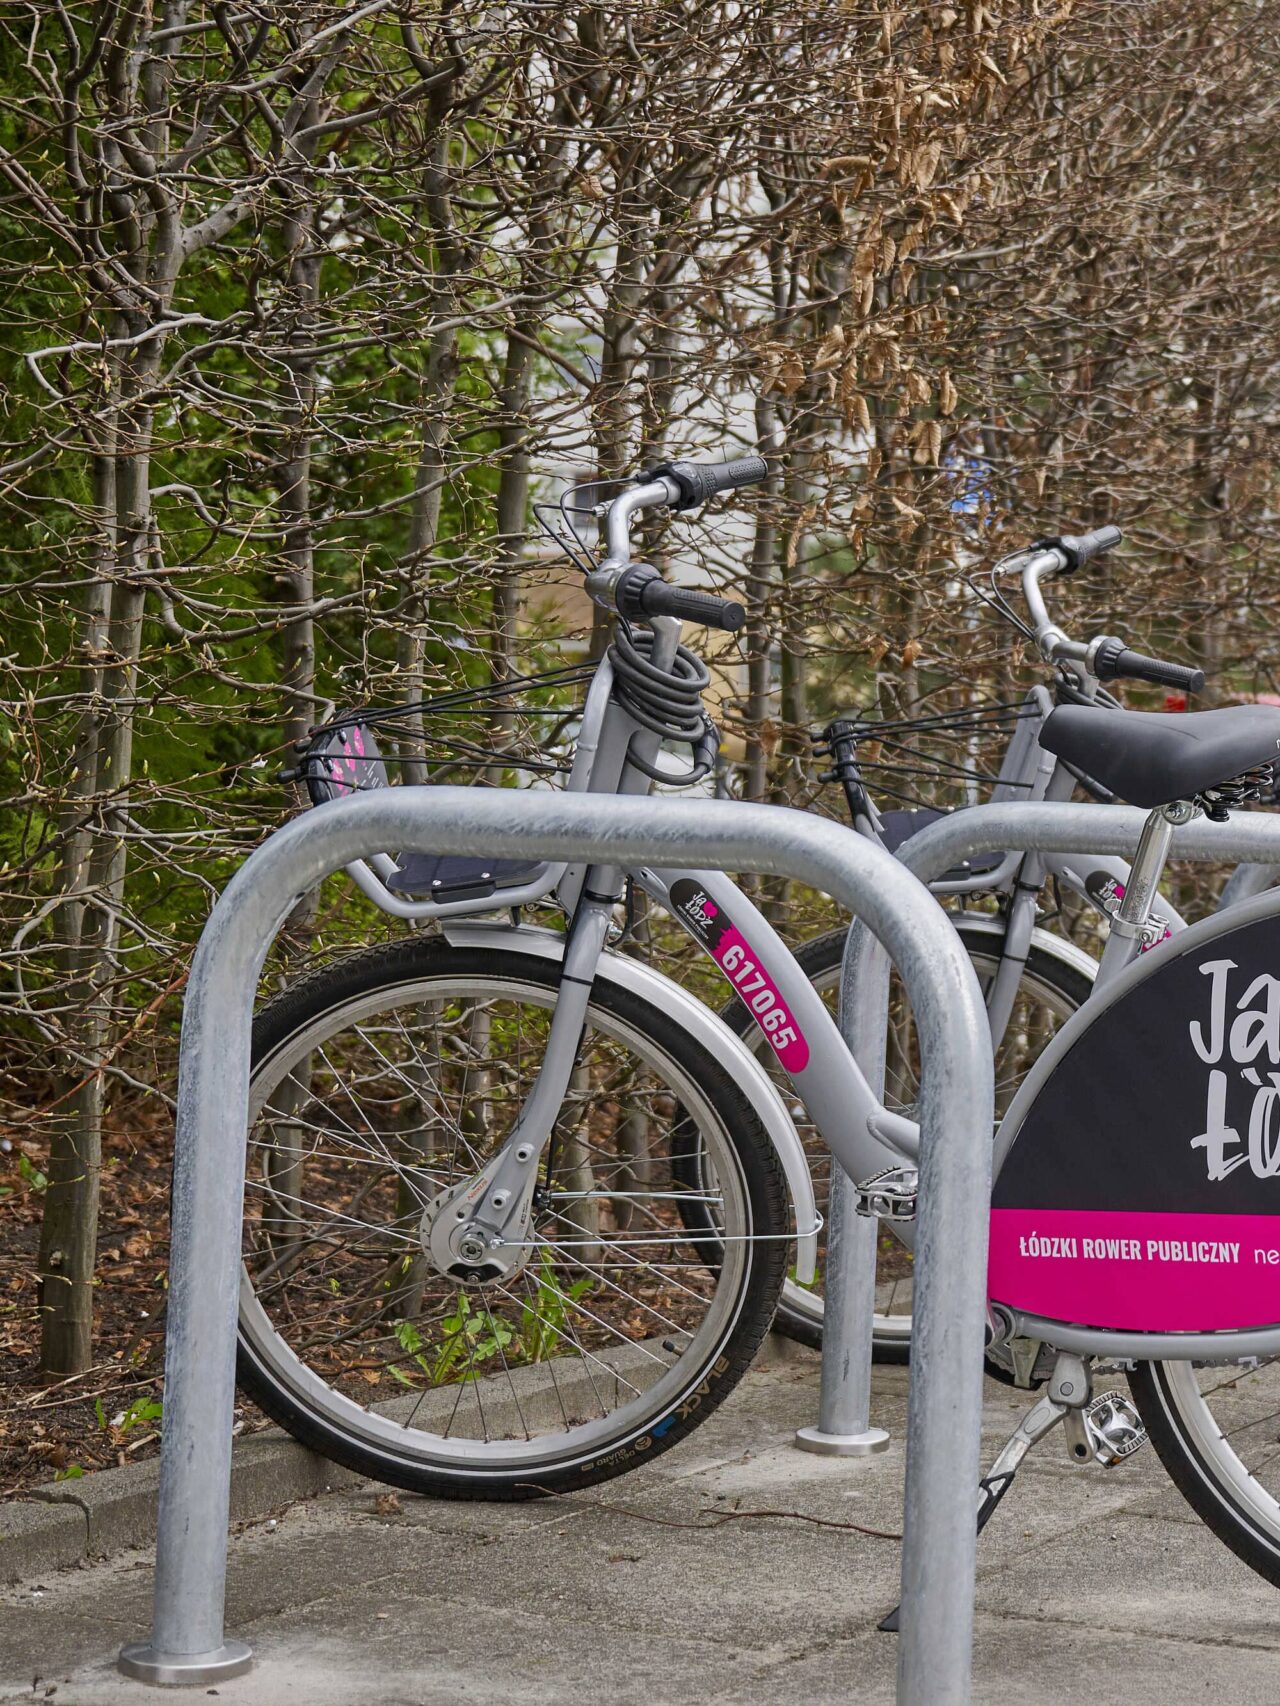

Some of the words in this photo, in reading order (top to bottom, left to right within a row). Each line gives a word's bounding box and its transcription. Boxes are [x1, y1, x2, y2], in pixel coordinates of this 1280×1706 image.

[722, 944, 797, 1050] 617065
[1019, 1231, 1077, 1258] ŁÓDZKI
[1083, 1238, 1142, 1261] ROWER
[1147, 1240, 1240, 1263] PUBLICZNY
[674, 1355, 730, 1420] BLACK
